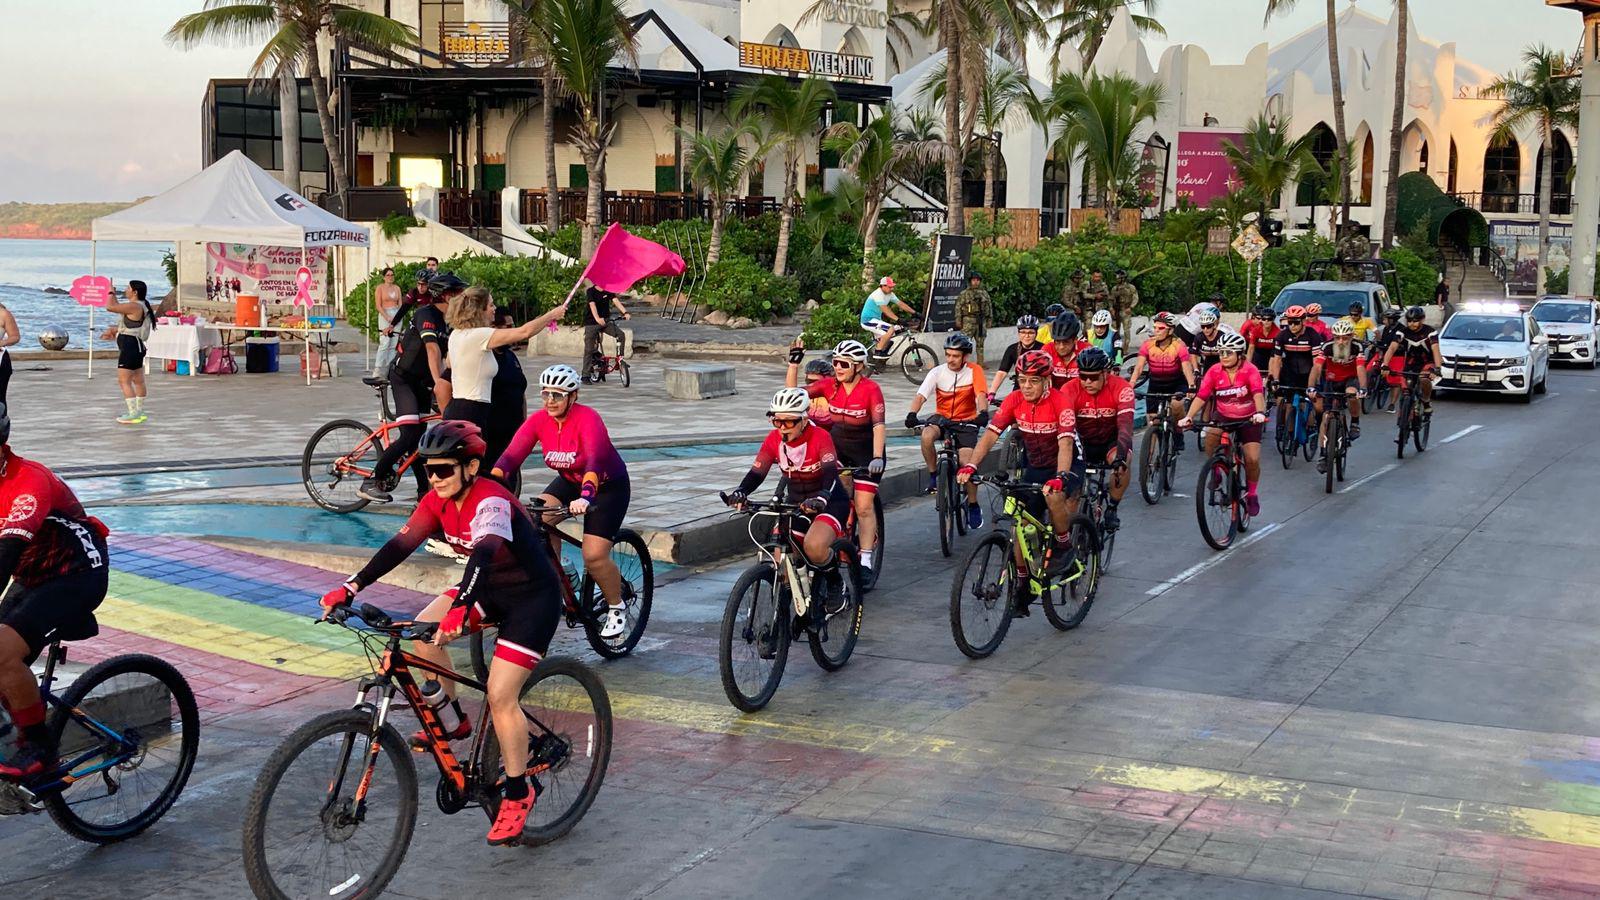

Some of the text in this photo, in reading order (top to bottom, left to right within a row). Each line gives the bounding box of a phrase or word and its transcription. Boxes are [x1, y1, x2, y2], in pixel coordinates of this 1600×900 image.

[444, 37, 505, 53] TERRAZA
[743, 43, 874, 76] TERRAZA VALENTINO
[272, 257, 301, 265] AMOR
[936, 264, 965, 279] TERRAZA
